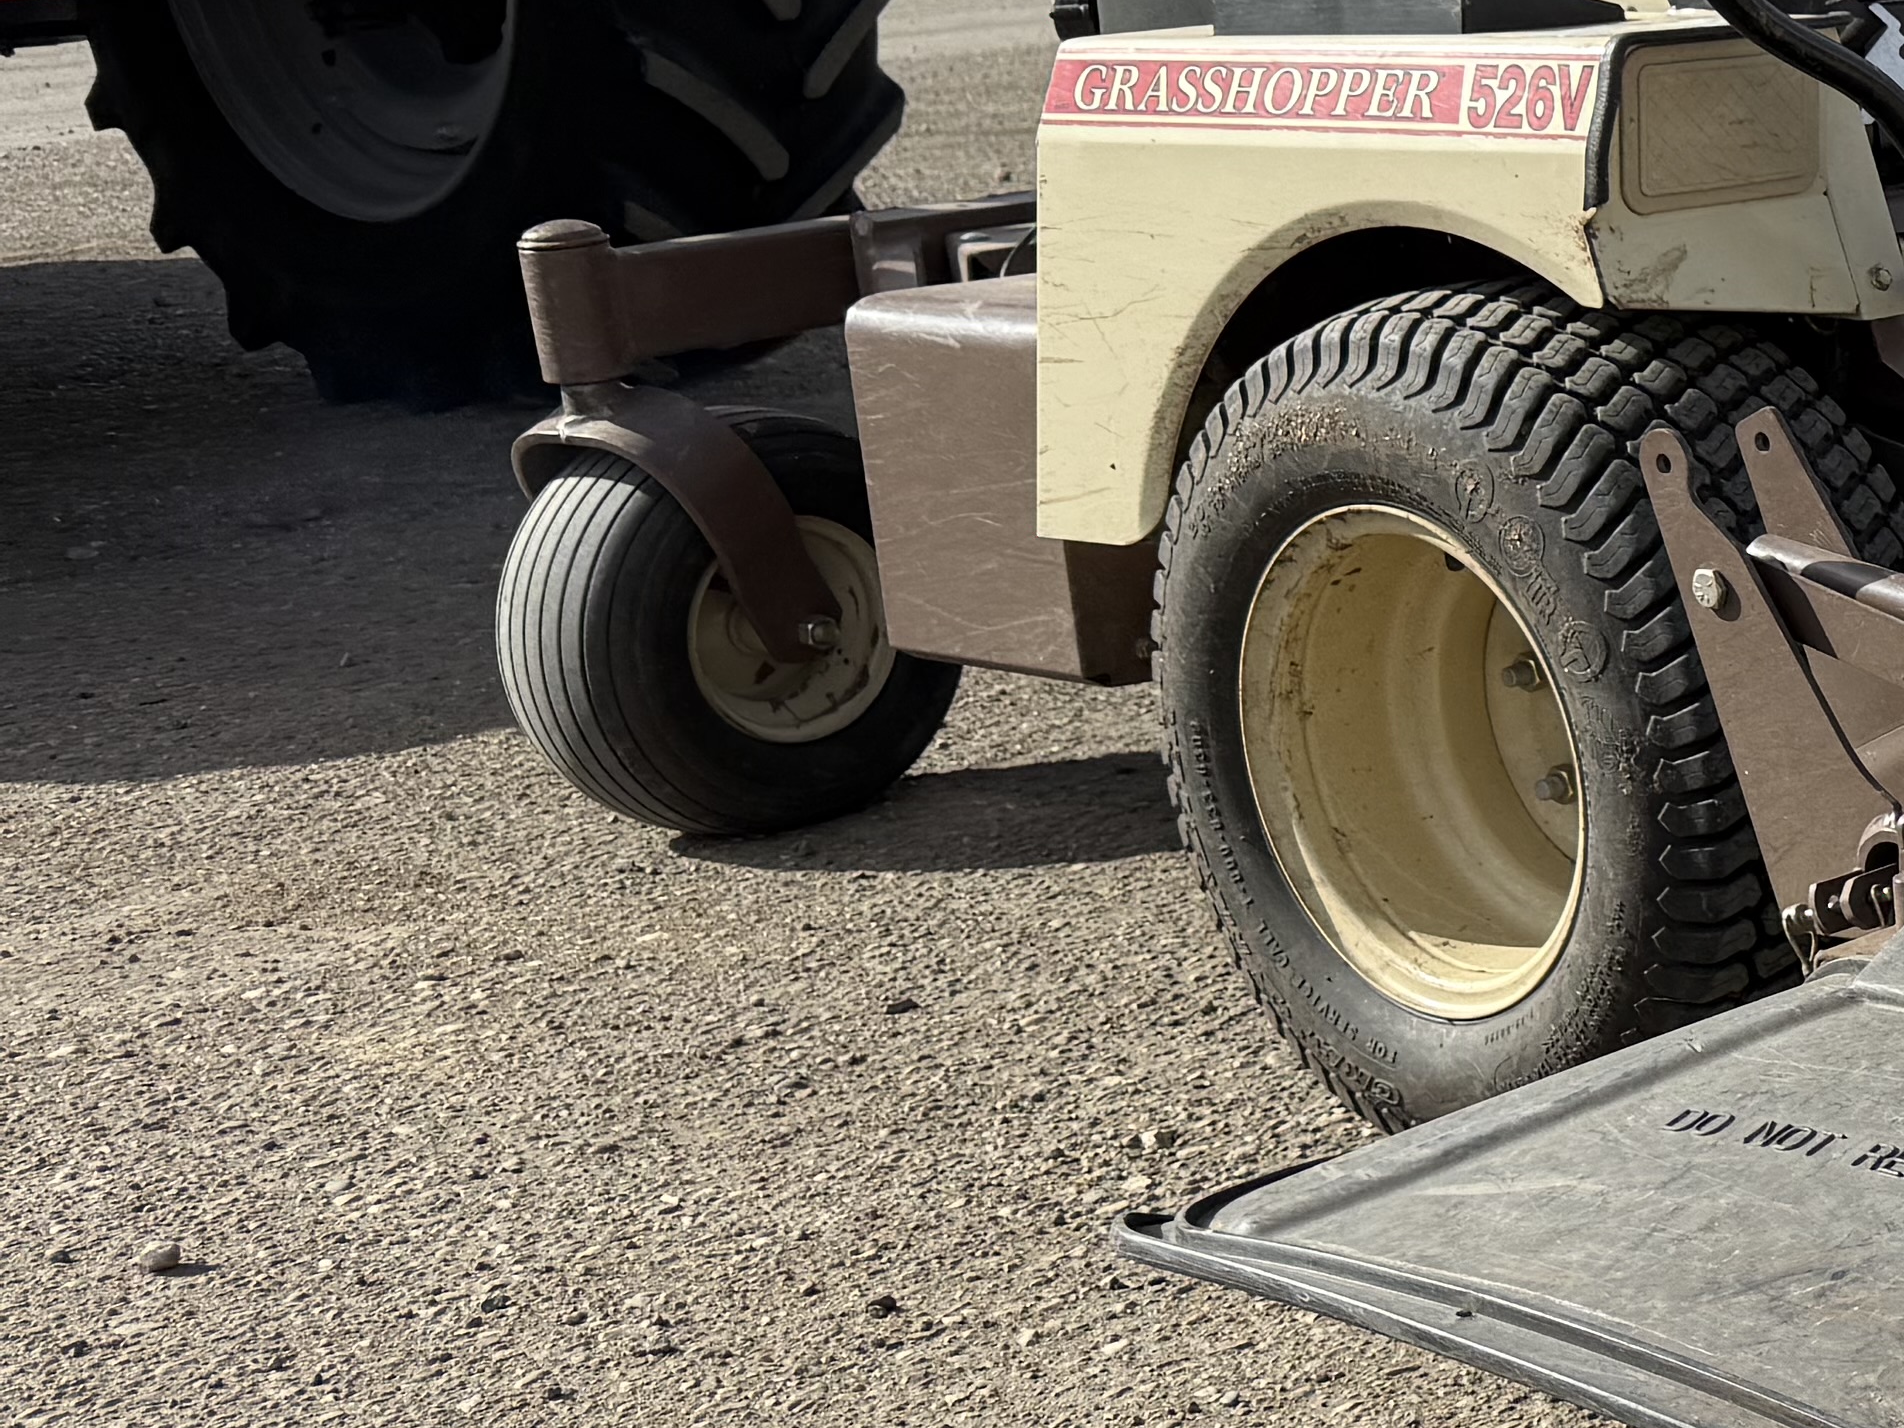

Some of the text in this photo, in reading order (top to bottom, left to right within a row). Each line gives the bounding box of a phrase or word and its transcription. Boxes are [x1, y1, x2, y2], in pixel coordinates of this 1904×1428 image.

[1072, 61, 1597, 133] GRASSHOPPER 526V
[1662, 1108, 1736, 1137] DO
[1743, 1119, 1849, 1157] NOT
